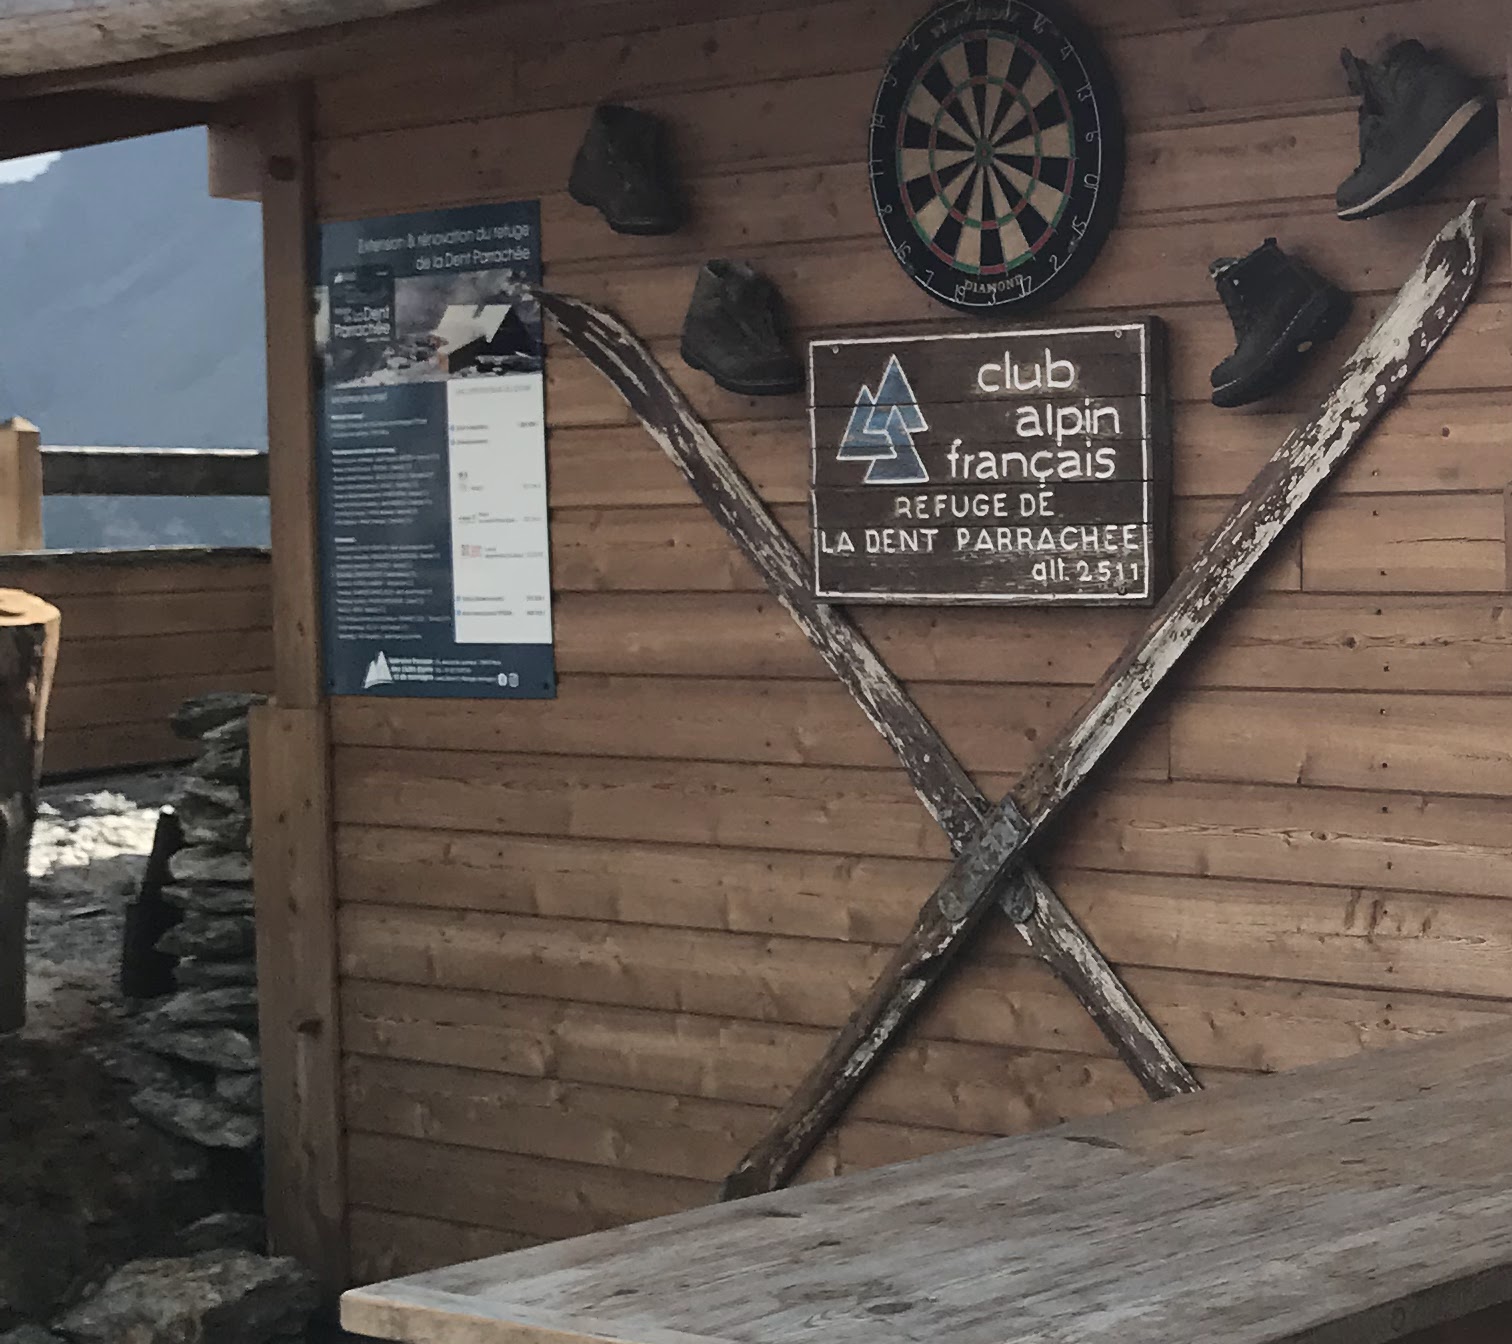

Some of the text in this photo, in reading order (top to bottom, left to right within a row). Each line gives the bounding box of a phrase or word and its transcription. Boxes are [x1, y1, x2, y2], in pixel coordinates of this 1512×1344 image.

[476, 227, 491, 241] du
[1071, 216, 1086, 236] 15
[416, 256, 431, 271] de
[445, 252, 471, 267] Dent
[977, 347, 1075, 393] club
[1016, 398, 1121, 446] alpin
[946, 439, 1117, 488] français
[895, 491, 1055, 519] REFUGE DE
[821, 524, 1139, 554] LA DENT PARRACHEE
[1077, 559, 1139, 583] 2511
